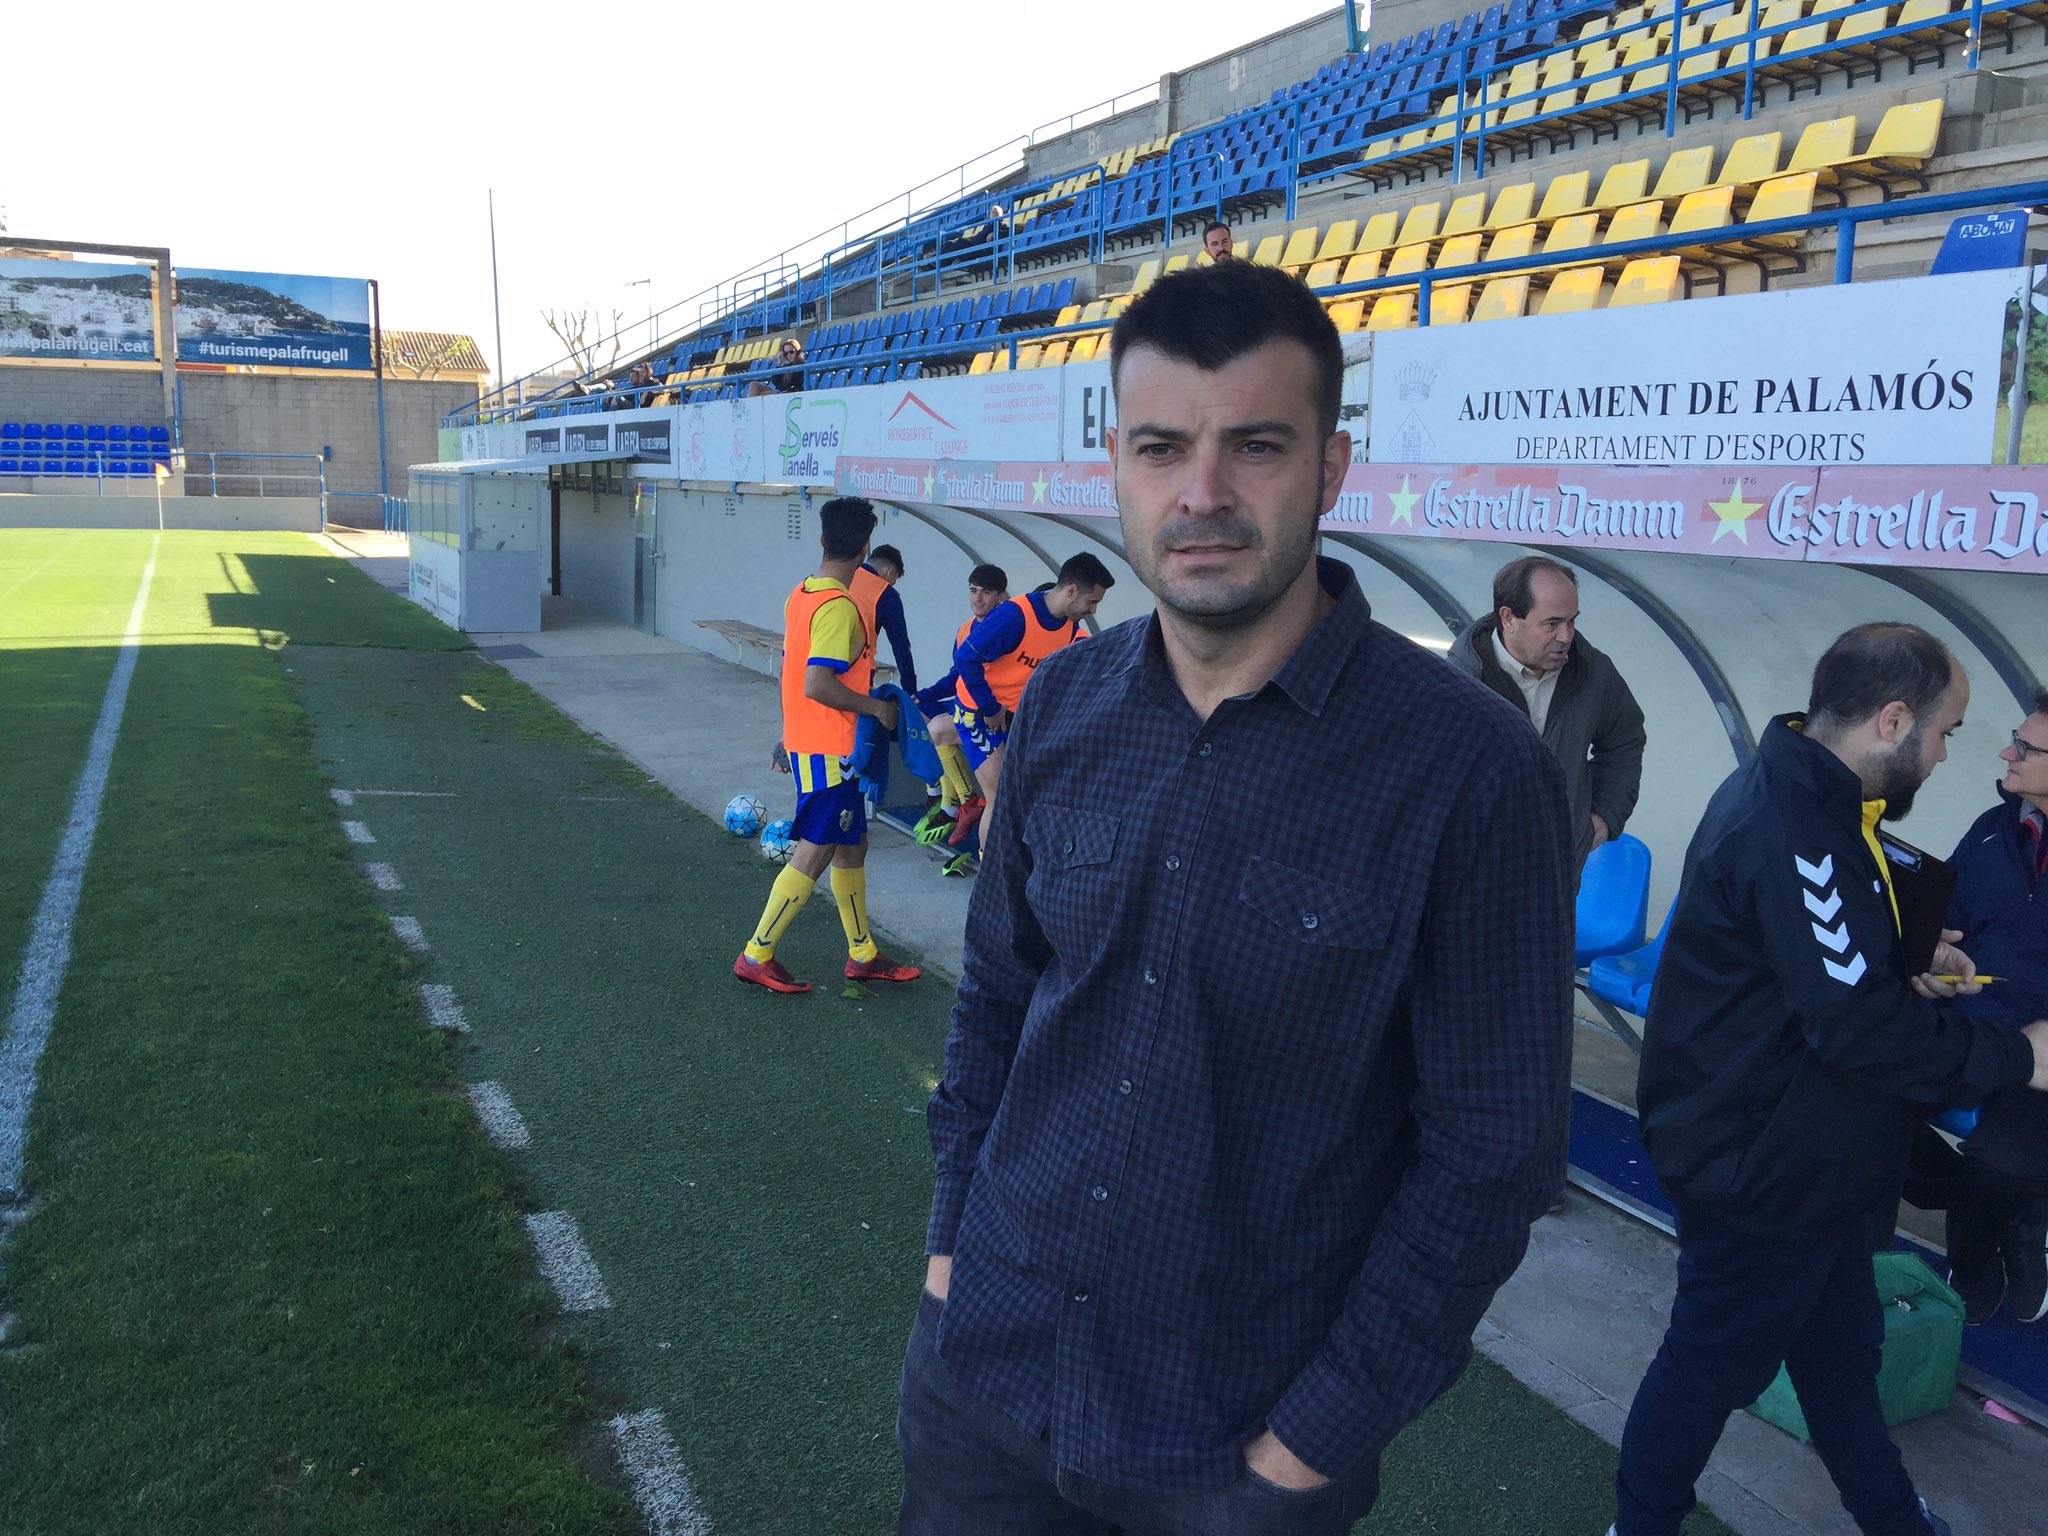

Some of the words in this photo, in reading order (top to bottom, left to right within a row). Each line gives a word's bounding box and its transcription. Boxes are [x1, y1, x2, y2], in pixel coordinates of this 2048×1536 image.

[199, 341, 349, 363] #turismepalafrugell
[1458, 383, 1677, 421] AJUNTAMENT
[1688, 380, 1739, 415] DE
[1752, 358, 1975, 414] PALAMÓS
[779, 397, 839, 457] Serveis
[934, 440, 969, 454] CALONGE
[1515, 434, 1697, 461] DEPARTAMENT
[1705, 432, 1866, 462] D'ESPORTS
[850, 463, 885, 491] Estrella
[885, 467, 918, 495] Damm
[938, 466, 981, 500] Estrella
[983, 473, 1025, 504] Damm
[1049, 469, 1111, 507] Estrella
[1423, 477, 1551, 533] Estrella
[1553, 484, 1685, 539] Damm
[1767, 481, 1978, 553] Estrella
